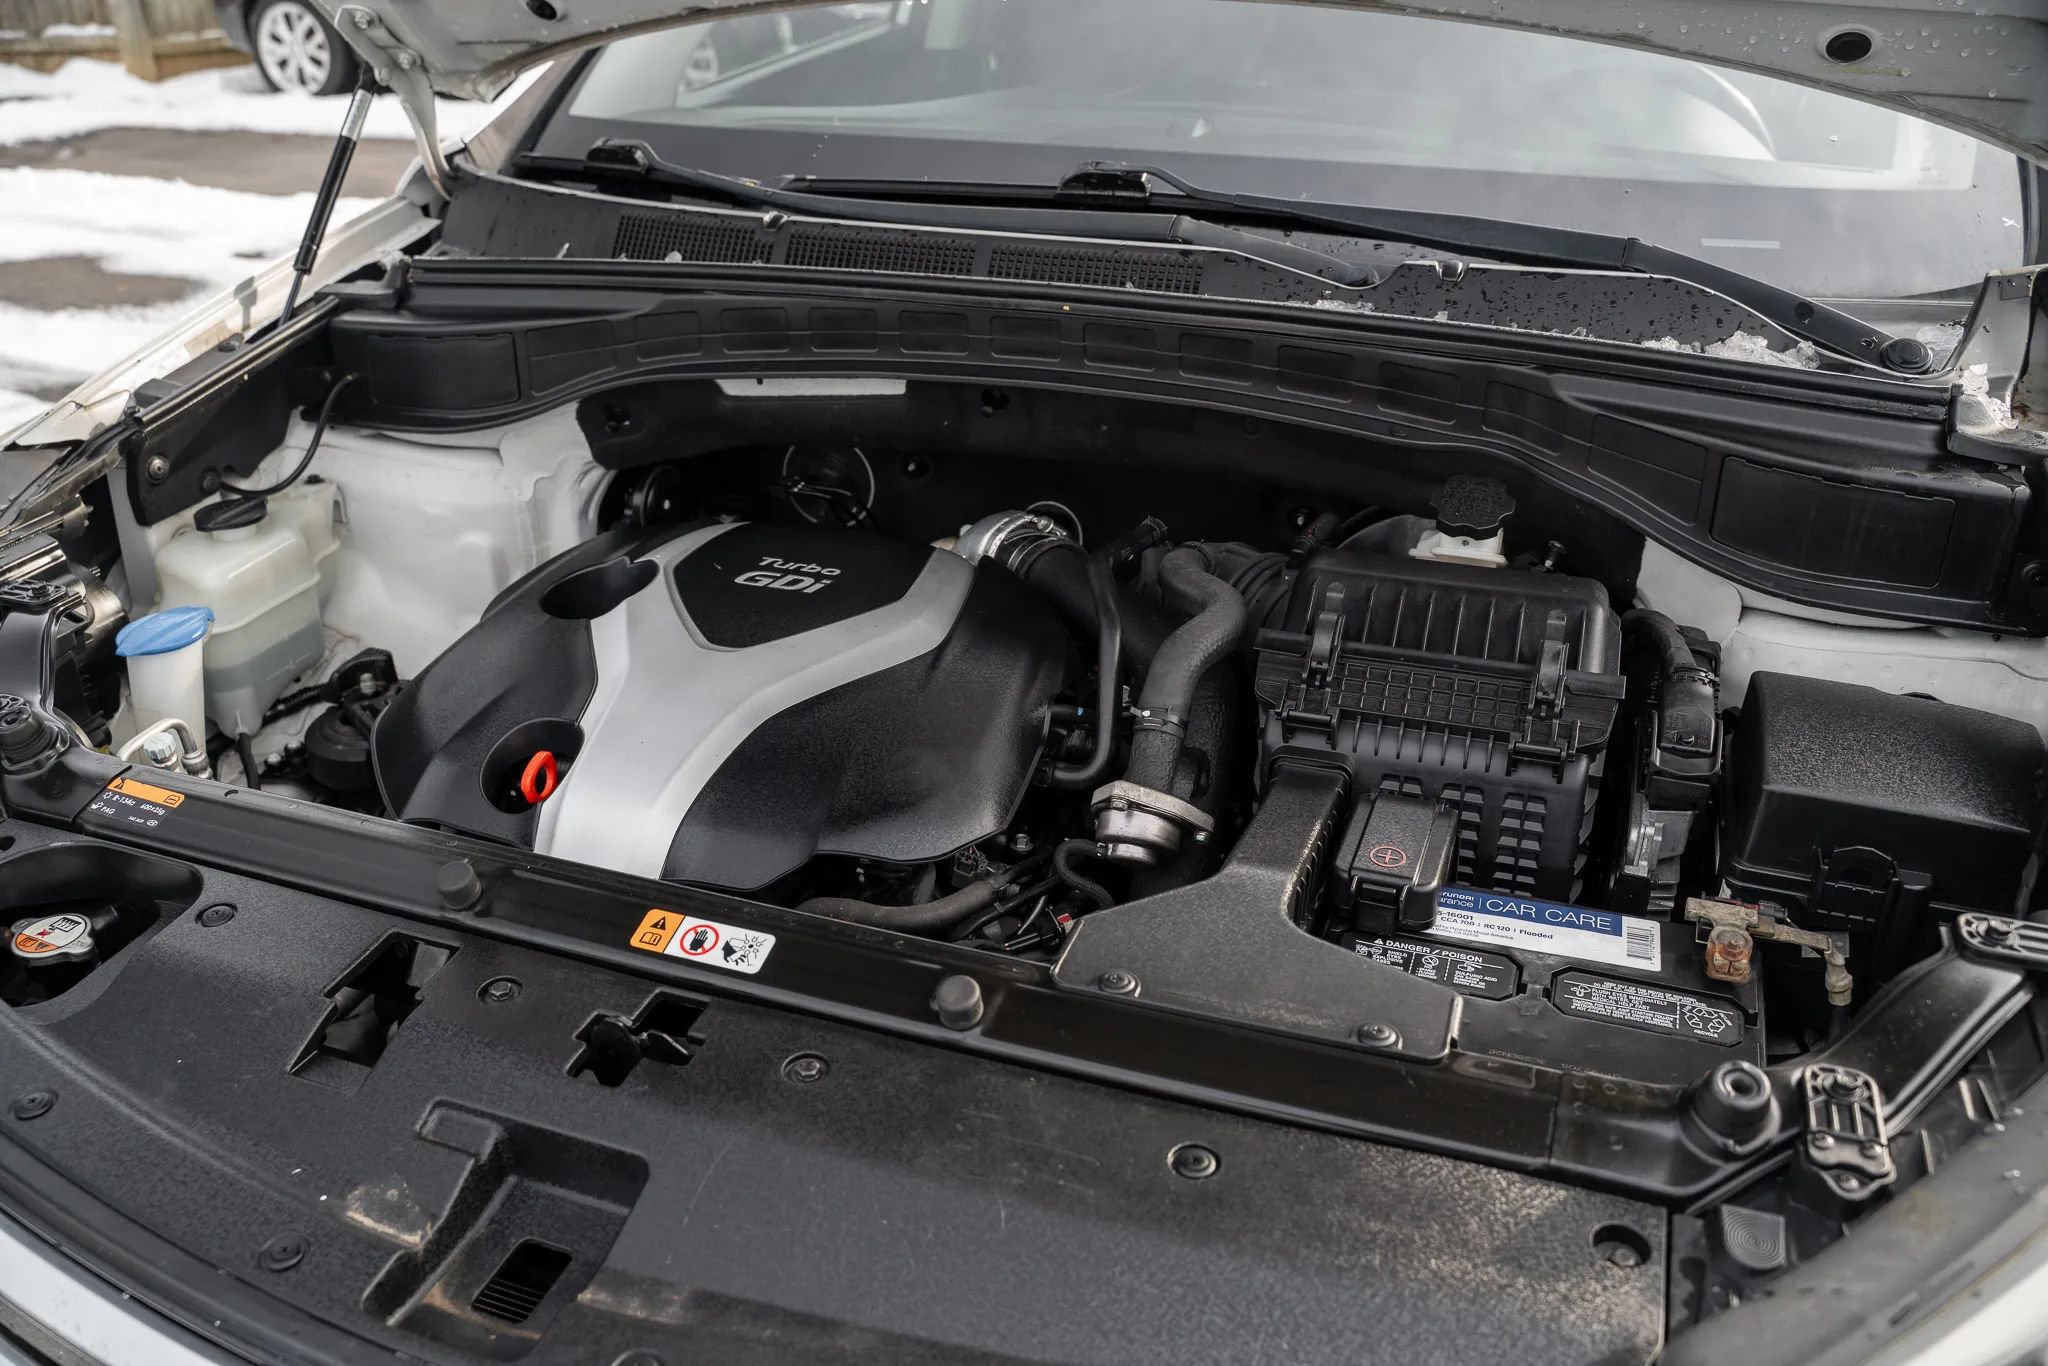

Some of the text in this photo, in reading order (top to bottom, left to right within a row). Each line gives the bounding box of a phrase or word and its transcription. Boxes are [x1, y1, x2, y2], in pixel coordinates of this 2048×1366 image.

[758, 556, 841, 576] Turbo
[734, 570, 833, 593] GDi
[1486, 899, 1611, 930] CAR CARE
[1520, 929, 1553, 939] Flooded
[1386, 939, 1430, 954] DANGER
[1442, 950, 1482, 963] POISON
[1592, 996, 1616, 1004] MEDICAL
[1628, 995, 1667, 1006] IMMEDIATELY
